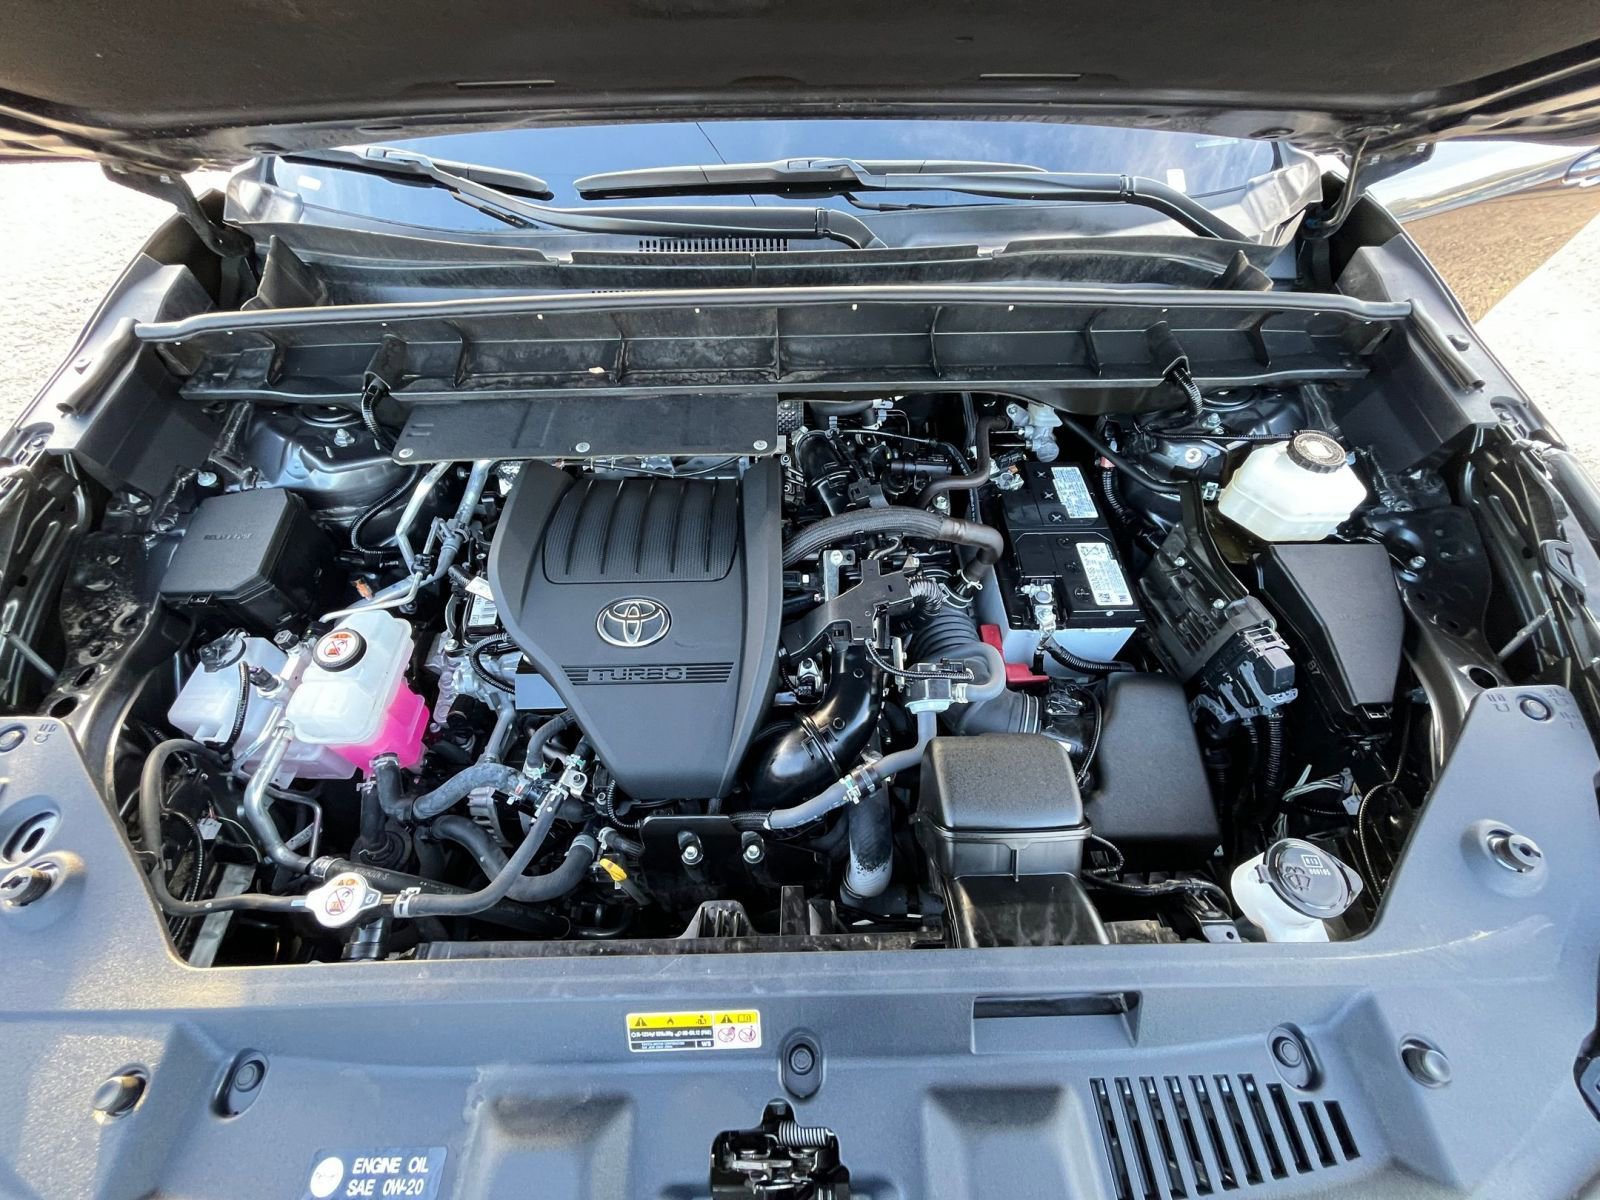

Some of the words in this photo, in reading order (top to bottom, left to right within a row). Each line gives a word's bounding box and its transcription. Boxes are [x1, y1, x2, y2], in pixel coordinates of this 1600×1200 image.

[592, 667, 683, 681] TURBO
[352, 1157, 402, 1175] ENGINE
[408, 1156, 429, 1174] OIL
[346, 1179, 376, 1196] SAE
[382, 1178, 424, 1196] 0W-20
